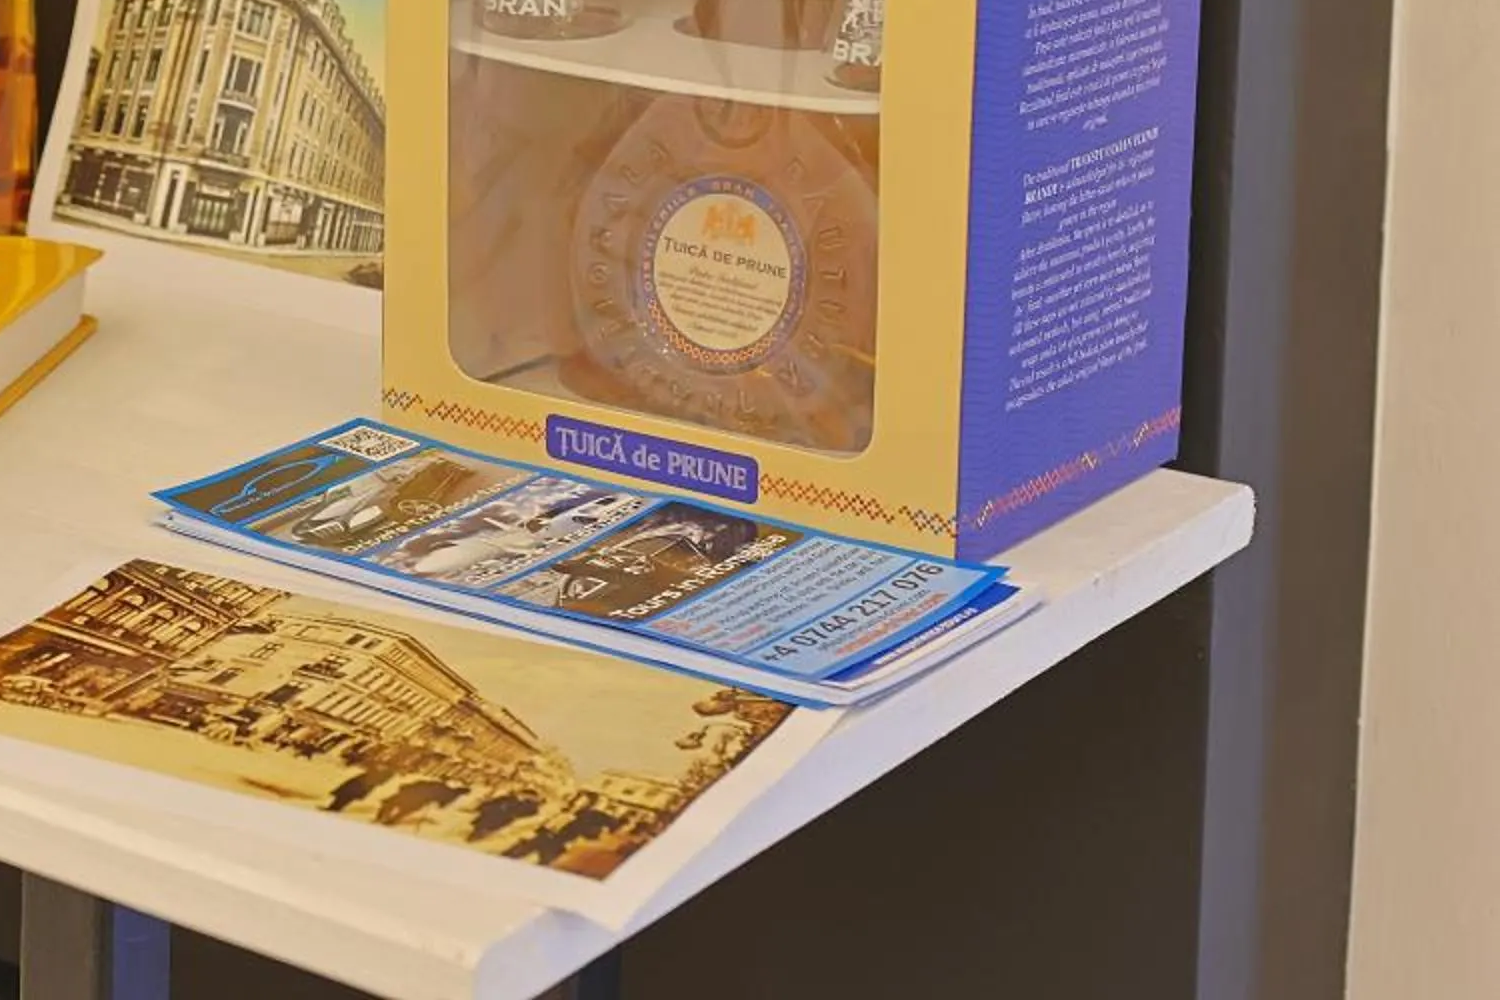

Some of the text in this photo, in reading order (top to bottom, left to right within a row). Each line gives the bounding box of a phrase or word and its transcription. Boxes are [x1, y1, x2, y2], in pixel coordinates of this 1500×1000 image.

[712, 251, 734, 266] DE
[735, 255, 788, 280] PRUNE
[631, 444, 661, 472] de
[666, 451, 748, 491] PRUNE
[608, 584, 684, 620] Tours
[760, 643, 799, 664] +4
[796, 614, 859, 648] 0744
[848, 589, 895, 617] 217
[891, 562, 945, 591] 076
